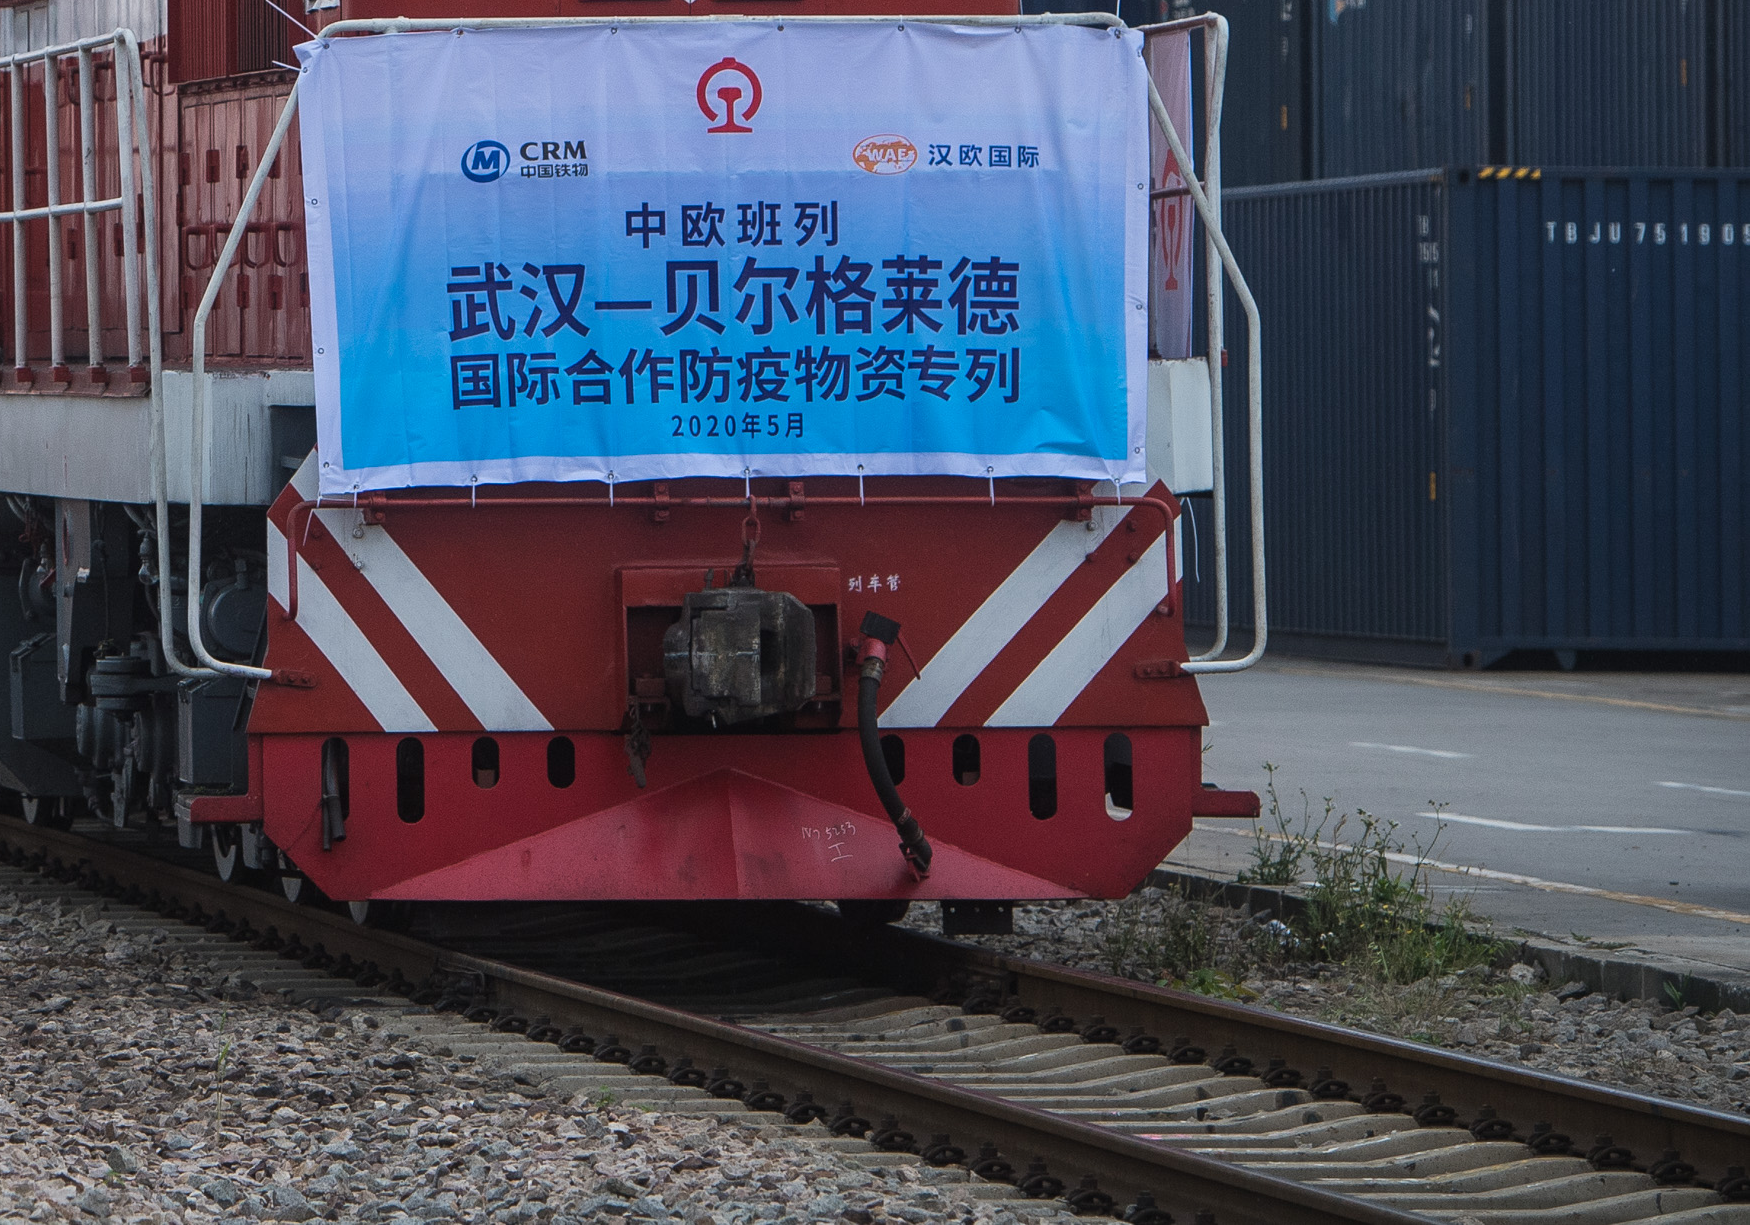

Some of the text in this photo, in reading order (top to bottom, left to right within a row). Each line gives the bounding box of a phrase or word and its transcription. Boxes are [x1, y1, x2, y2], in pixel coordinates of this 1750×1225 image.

[520, 140, 588, 162] CRM
[928, 144, 1040, 168] 汉欧国际
[520, 163, 588, 179] 中国铁物
[624, 201, 839, 249] 中欧班列
[450, 344, 1021, 410] 国际合作防疫物资专列
[671, 412, 804, 439] 2020年5月
[848, 574, 901, 592] 列车管
